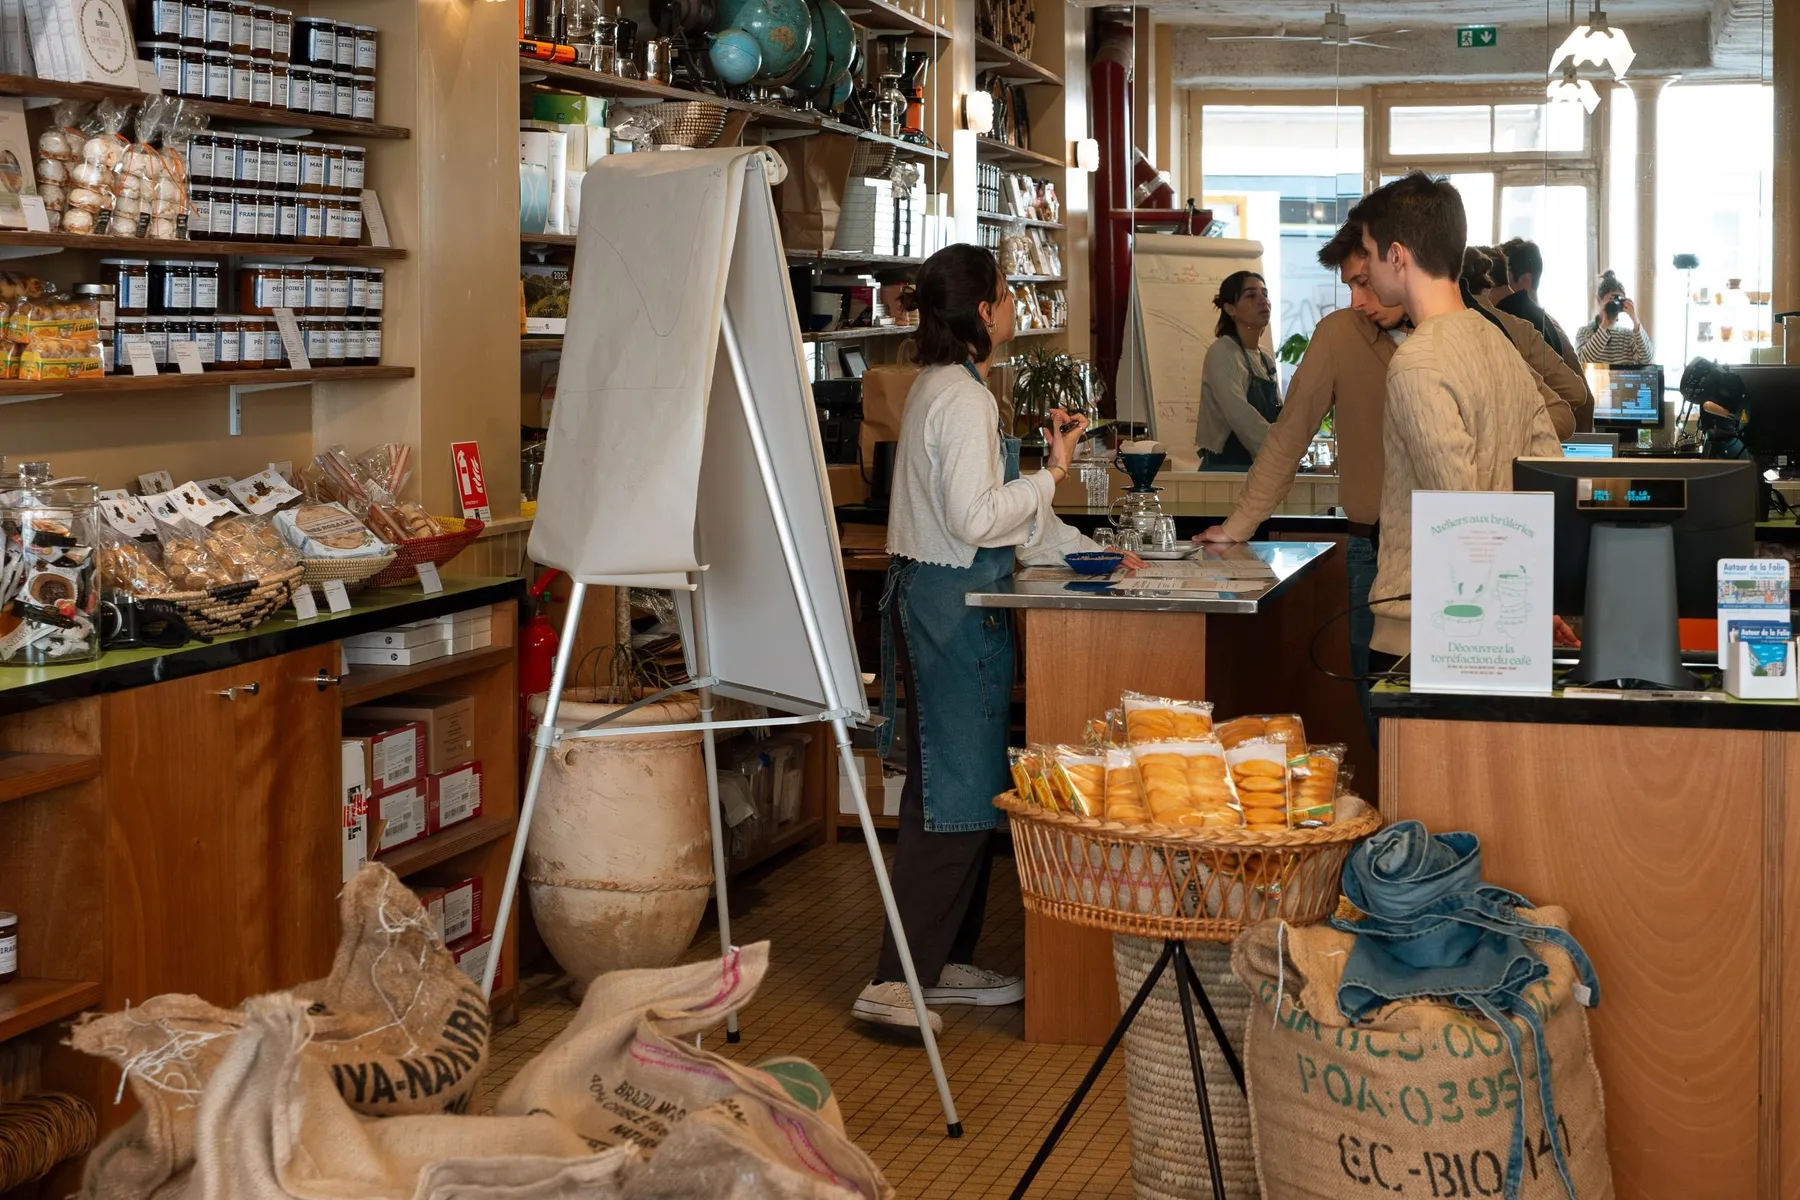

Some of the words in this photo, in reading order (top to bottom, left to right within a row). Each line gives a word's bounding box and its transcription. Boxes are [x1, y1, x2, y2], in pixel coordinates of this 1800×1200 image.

[553, 271, 568, 280] 2025
[1430, 517, 1470, 537] Ateliers
[1469, 515, 1490, 524] aux
[1490, 513, 1536, 539] brûleries
[1723, 562, 1748, 572] Autour
[1749, 562, 1758, 572] de
[1759, 562, 1767, 572] la
[1768, 562, 1787, 572] Folie
[1740, 628, 1760, 637] Autour
[1761, 628, 1769, 637] de
[1769, 628, 1776, 637] la
[1776, 628, 1791, 638] Folie
[1448, 641, 1504, 653] Découvrez
[1505, 643, 1515, 654] la
[1431, 653, 1494, 665] torréfaction
[1493, 655, 1508, 665] du
[1509, 655, 1532, 666] café
[614, 1080, 655, 1112] BRAZIL
